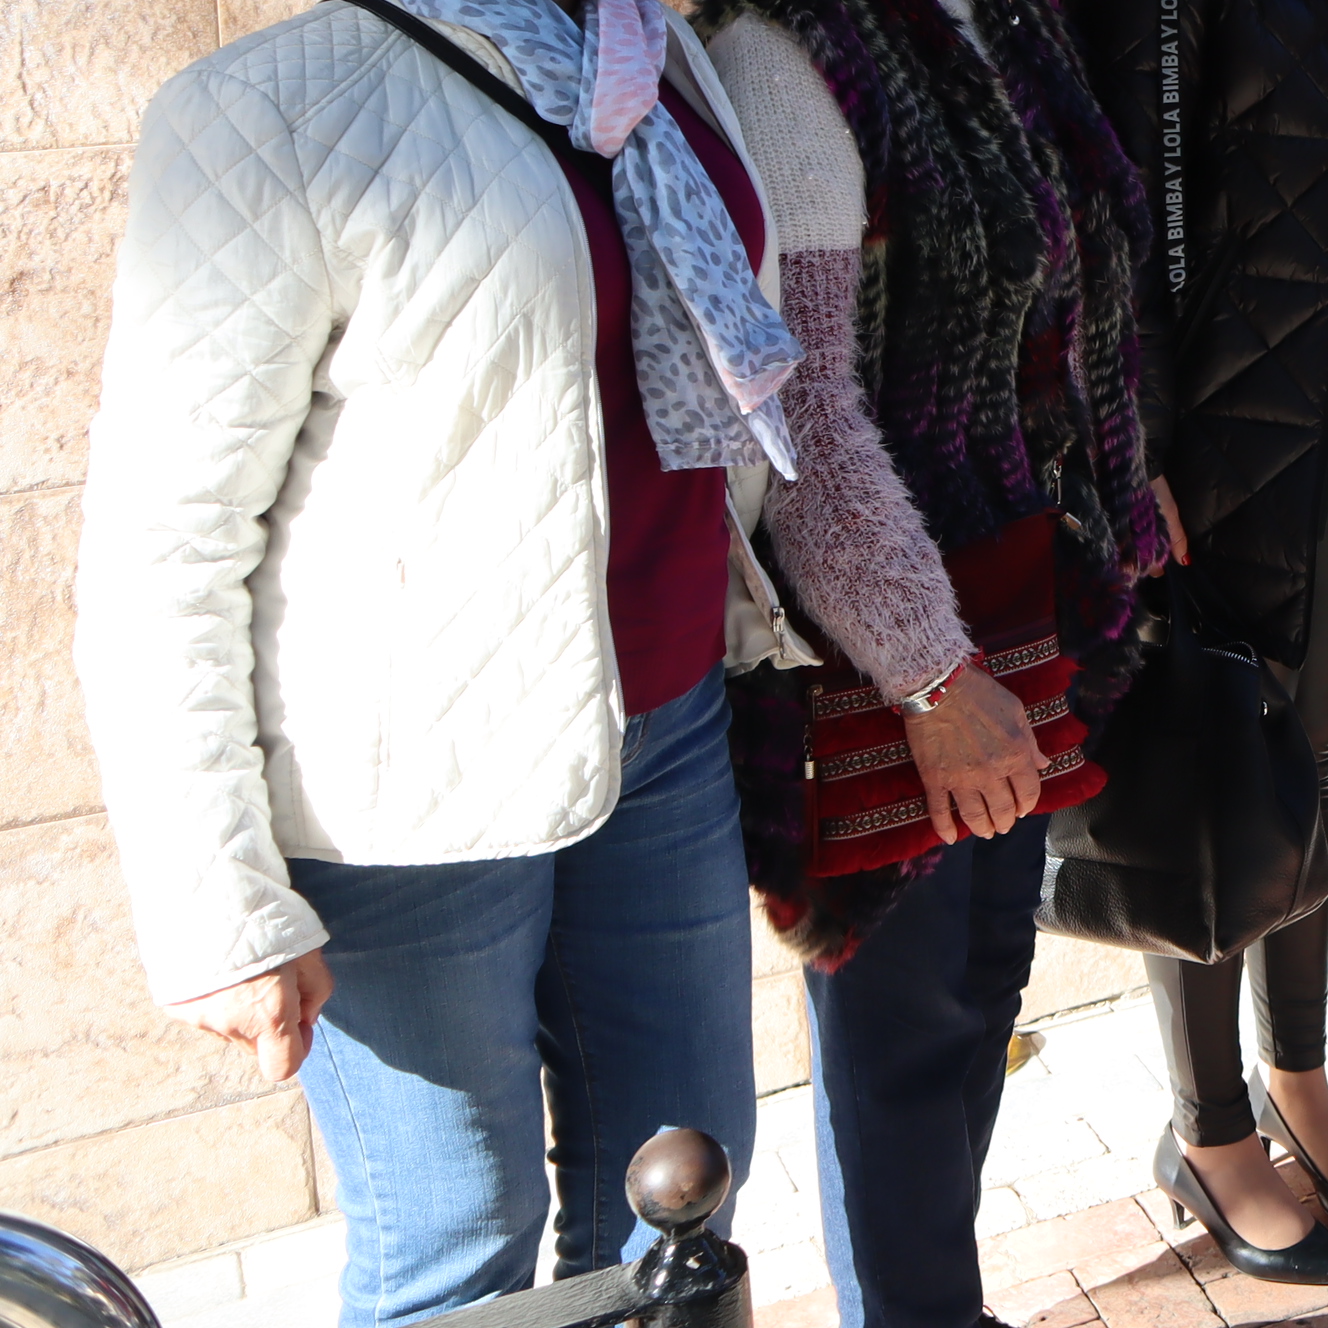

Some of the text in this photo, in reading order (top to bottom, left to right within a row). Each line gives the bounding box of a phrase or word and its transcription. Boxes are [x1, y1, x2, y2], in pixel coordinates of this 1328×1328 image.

[1161, 23, 1178, 40] Y
[1161, 40, 1180, 104] BIMBA
[1163, 108, 1181, 160] LOLA
[1165, 163, 1182, 178] Y
[1165, 180, 1185, 242] BIMBA
